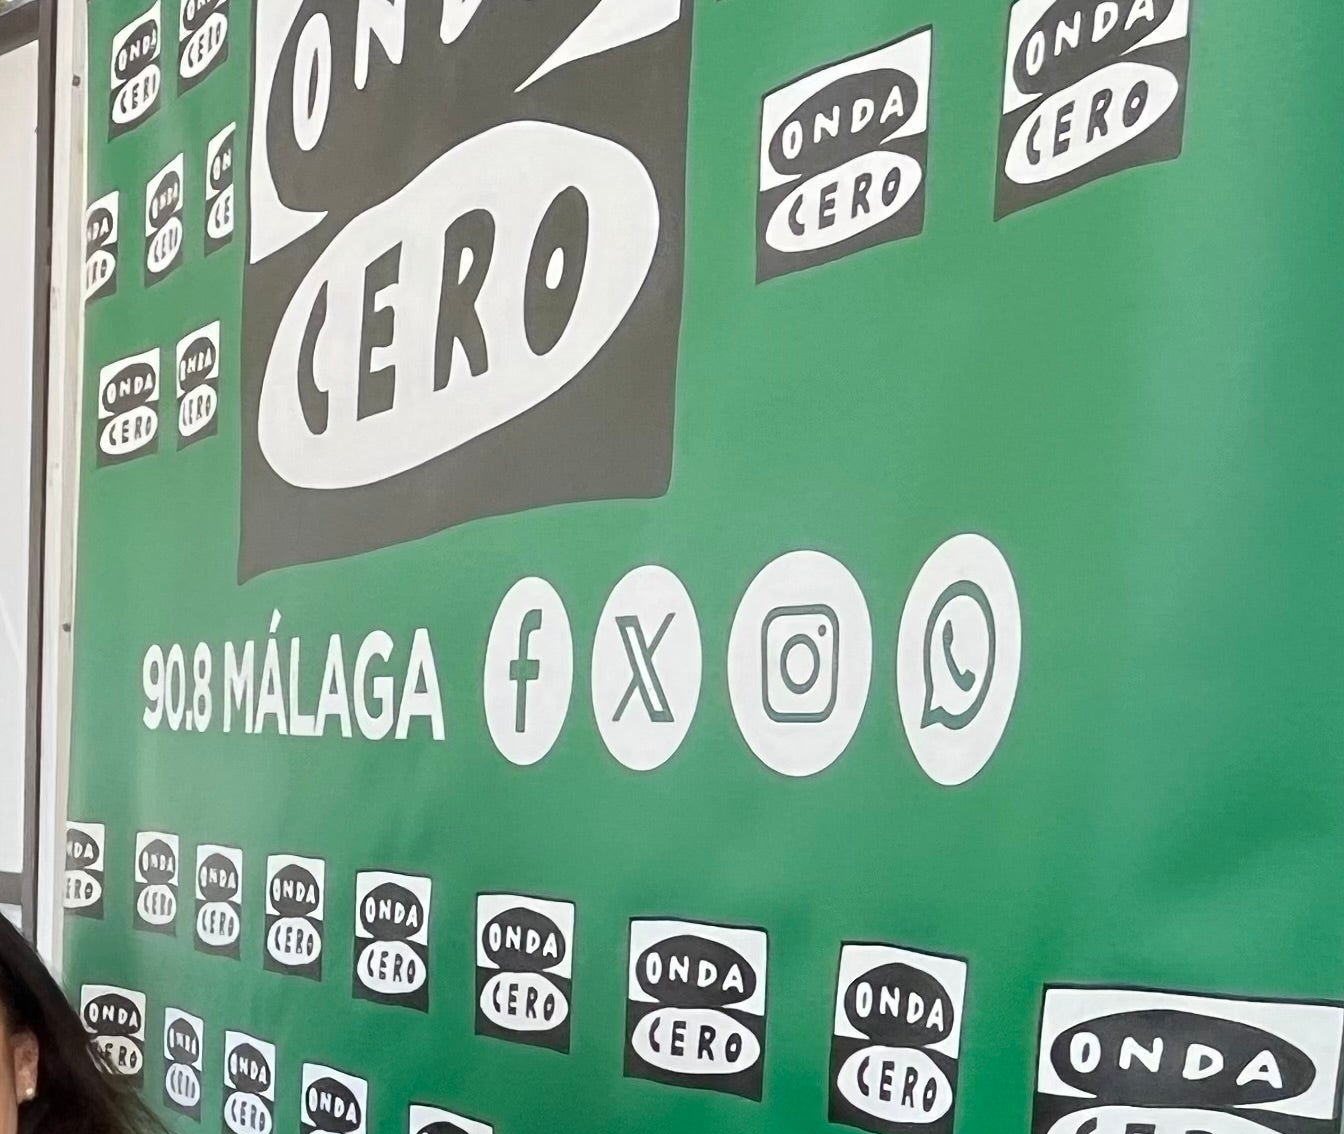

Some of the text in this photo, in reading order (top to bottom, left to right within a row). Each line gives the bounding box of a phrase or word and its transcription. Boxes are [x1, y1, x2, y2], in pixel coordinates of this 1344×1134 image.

[1025, 0, 1157, 76] ONDA
[782, 84, 904, 160] ONDA
[1025, 79, 1150, 166] CERO
[788, 165, 902, 237] CERO
[298, 186, 589, 436] CERO
[106, 372, 154, 405] ONDA
[108, 415, 152, 446] CERO
[142, 608, 446, 741] 90.8 MÁLAGA
[199, 865, 237, 890] ONDA
[271, 877, 317, 905] ONDA
[201, 908, 235, 938] CERO
[364, 897, 421, 928] ONDA
[274, 925, 314, 958] CERO
[489, 924, 558, 959] ONDA
[364, 952, 420, 986] CERO
[646, 951, 746, 995] ONDA
[88, 1002, 140, 1029] ONDA
[492, 982, 556, 1021] CERO
[855, 980, 946, 1034] ONDA
[648, 1018, 744, 1062] CERO
[230, 1052, 269, 1086] ONDA
[1068, 1031, 1284, 1091] ONDA
[856, 1053, 937, 1114] CERO
[231, 1097, 267, 1133] CERO
[308, 1087, 358, 1125] ONDA
